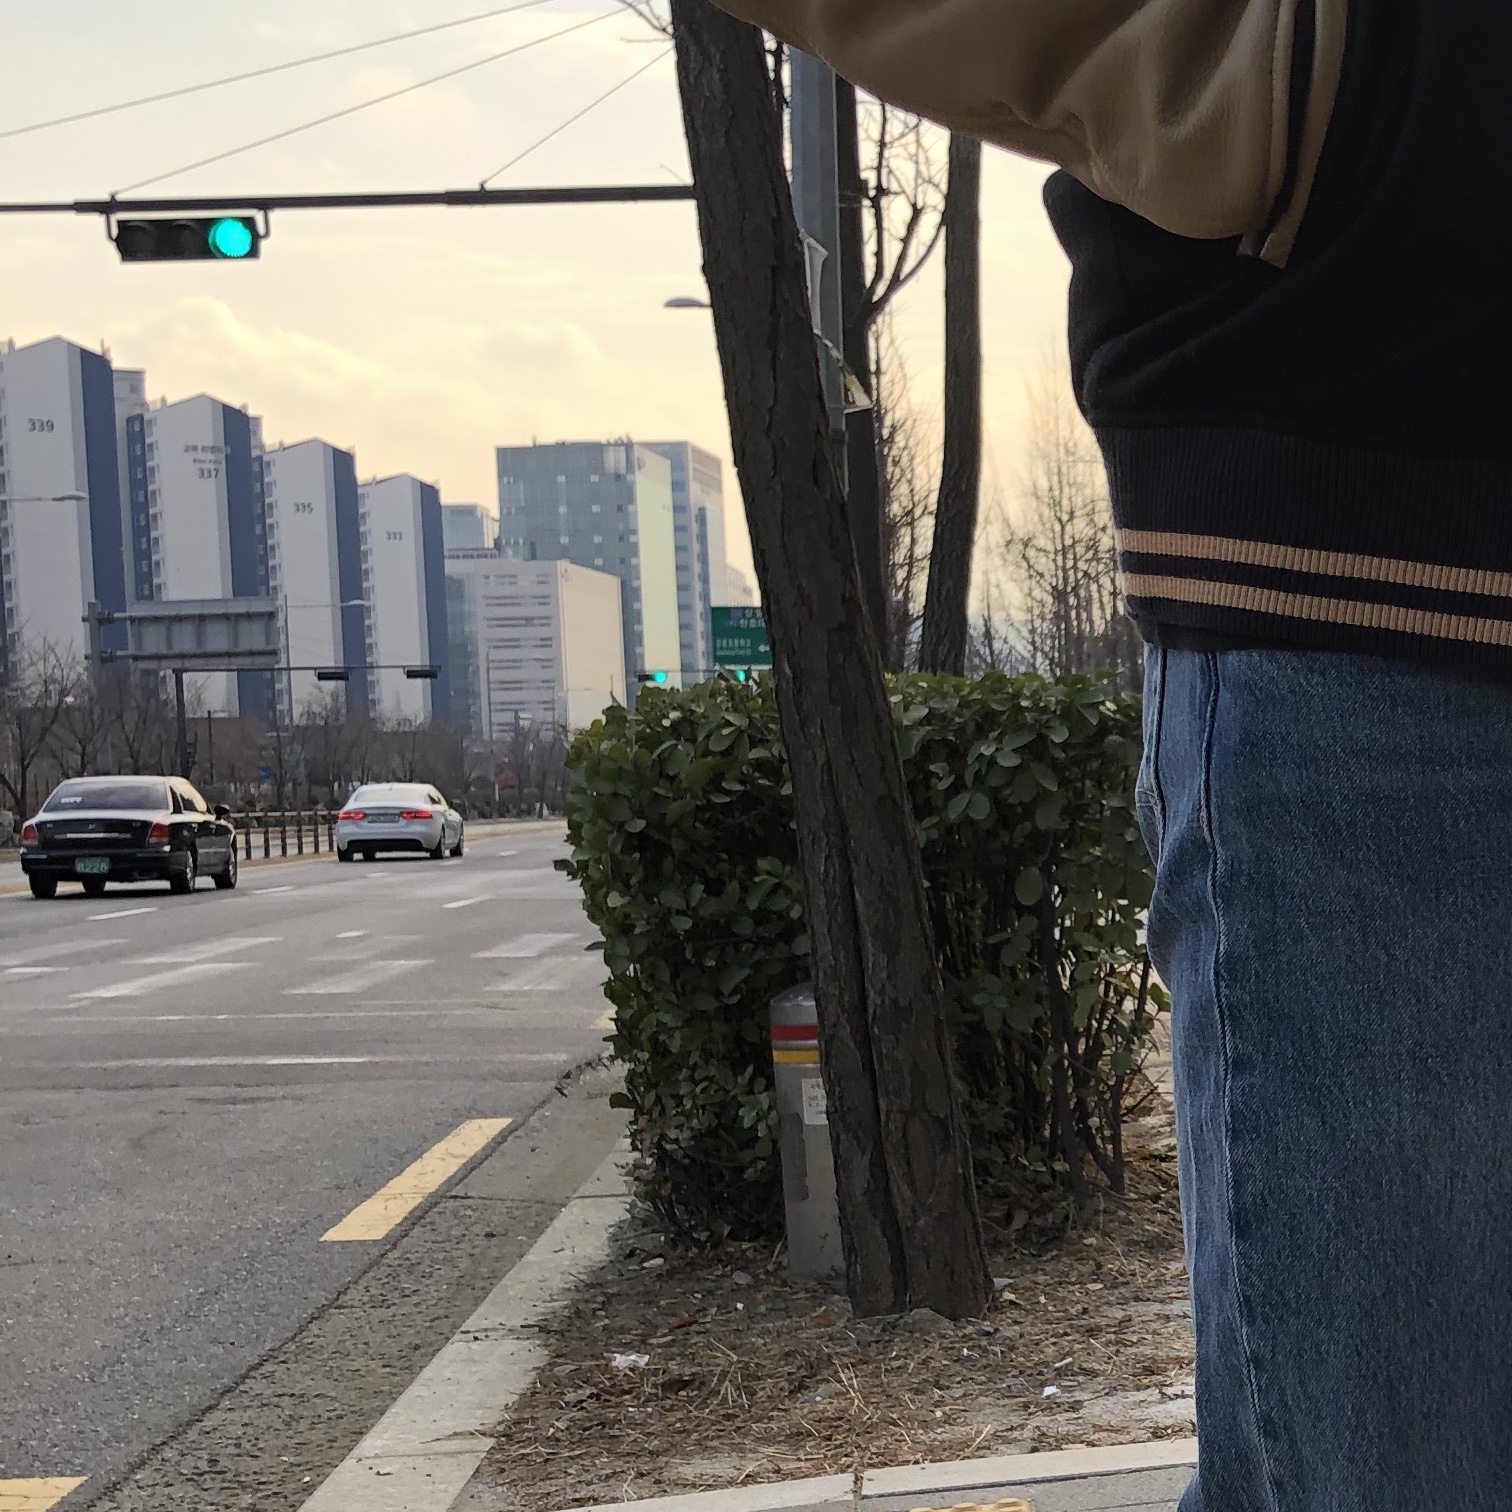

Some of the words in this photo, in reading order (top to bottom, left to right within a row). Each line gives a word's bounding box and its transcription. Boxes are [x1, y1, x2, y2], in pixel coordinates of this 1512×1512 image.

[28, 418, 54, 433] 339
[198, 468, 219, 479] 337
[293, 502, 313, 514] 335
[386, 531, 403, 541] 333
